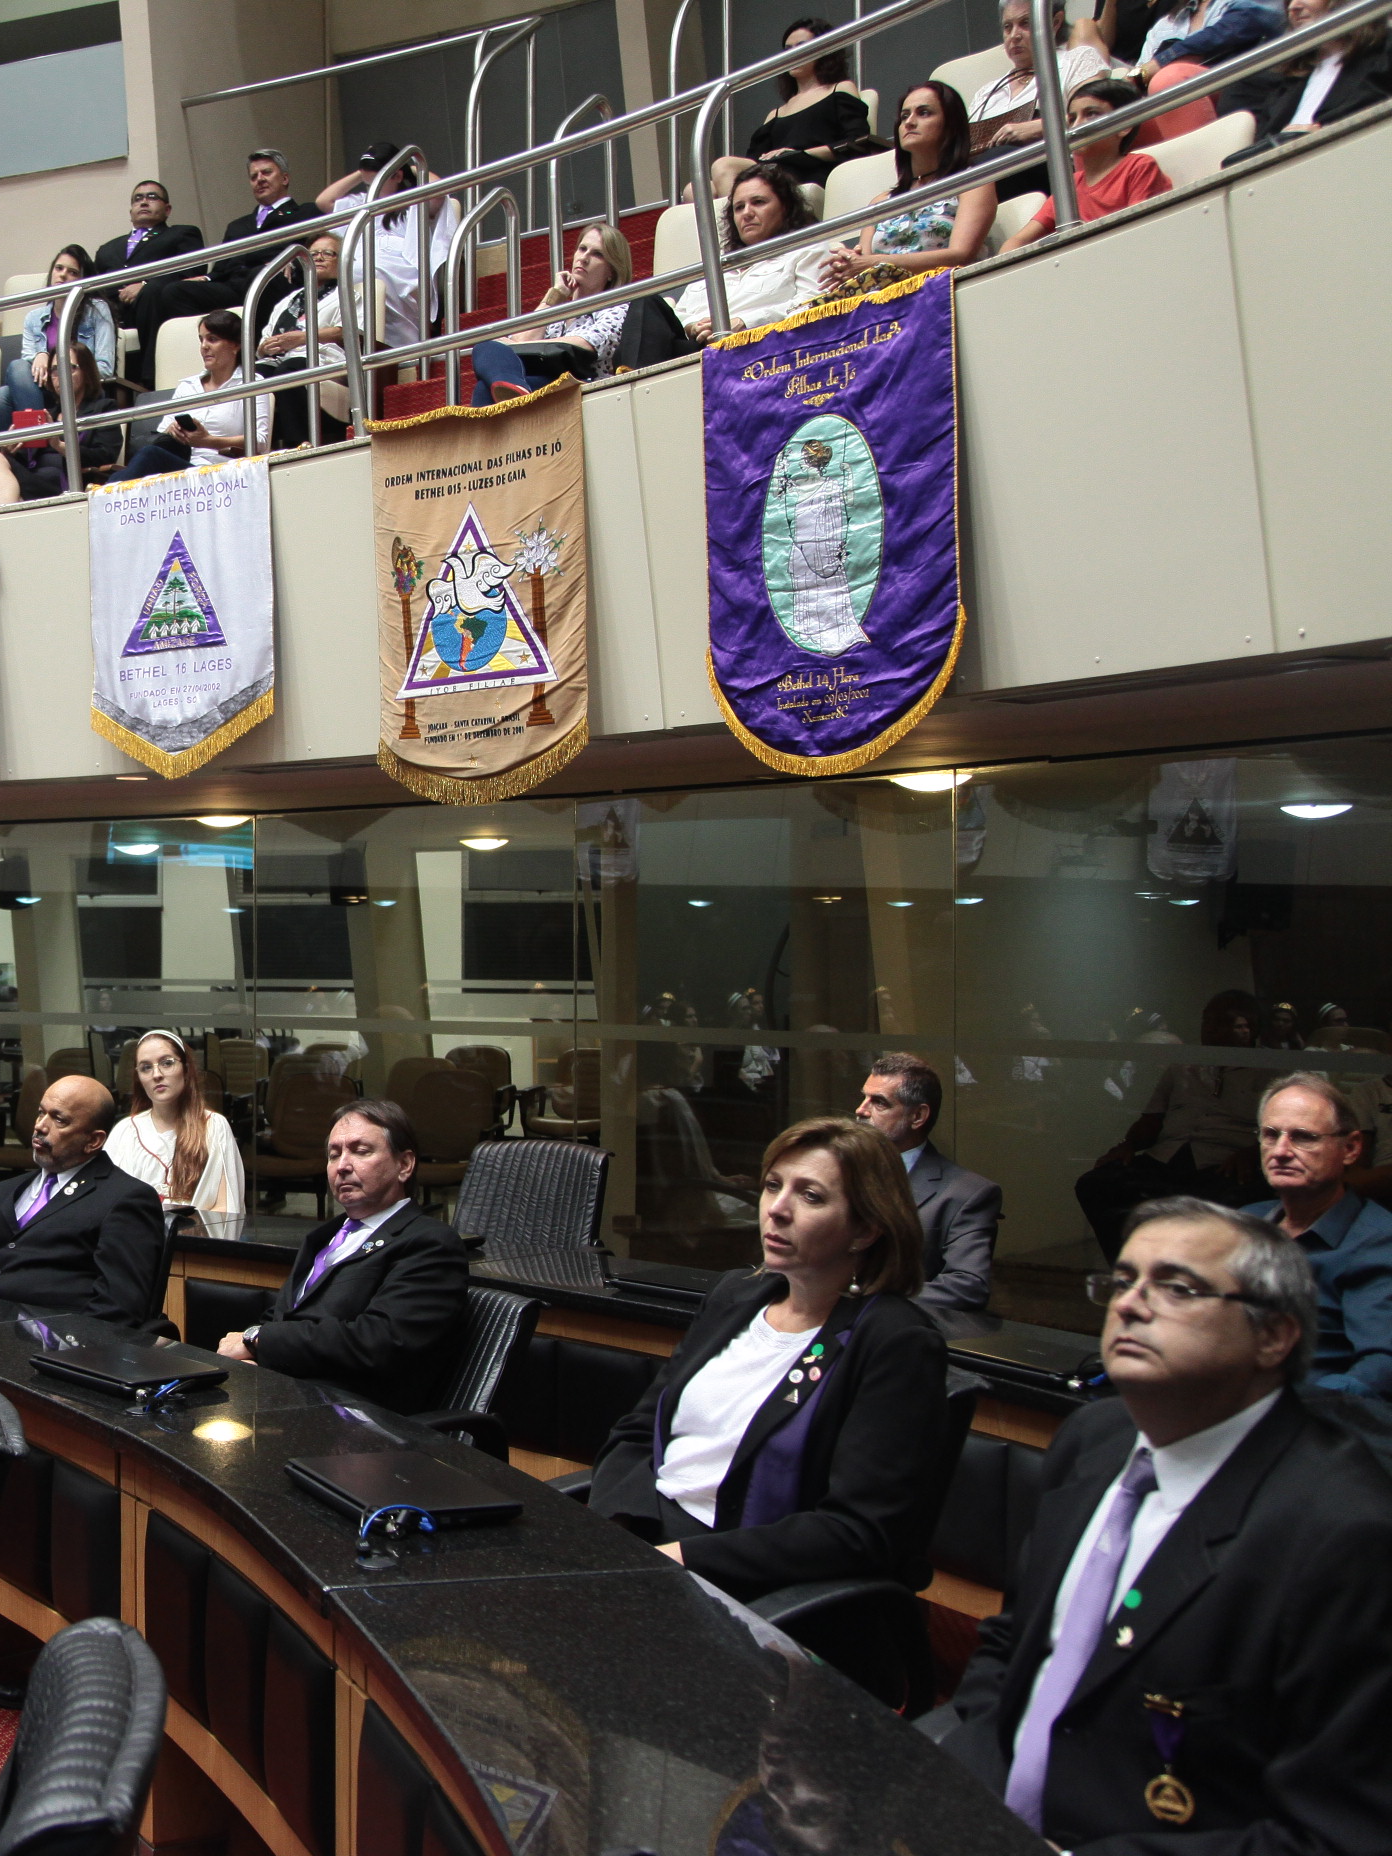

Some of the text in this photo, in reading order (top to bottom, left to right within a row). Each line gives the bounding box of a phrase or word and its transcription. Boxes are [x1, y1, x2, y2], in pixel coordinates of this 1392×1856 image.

[744, 322, 898, 381] Ordem Internacional das
[784, 361, 857, 399] Filhas de Jó
[384, 438, 562, 488] ORDEM INTERNACIONAL DAS FILHAS DE JÓ
[104, 477, 249, 514] ORDEM INTERNACIONAL
[414, 486, 446, 501] BETHEL
[447, 484, 462, 496] 015
[468, 477, 494, 492] LUZES
[495, 474, 507, 486] DE
[508, 468, 527, 483] GAIA
[120, 494, 232, 526] DAS FILHAS DE JÓ
[119, 658, 233, 682] BETHEL 16 LAGES
[152, 698, 179, 708] LAGES
[429, 678, 516, 696] IYOB FILIAE
[424, 734, 448, 745] FUNDADO
[464, 732, 472, 740] DE
[503, 727, 511, 736] DE
[453, 719, 469, 728] SANTA
[471, 716, 496, 727] CATARINA
